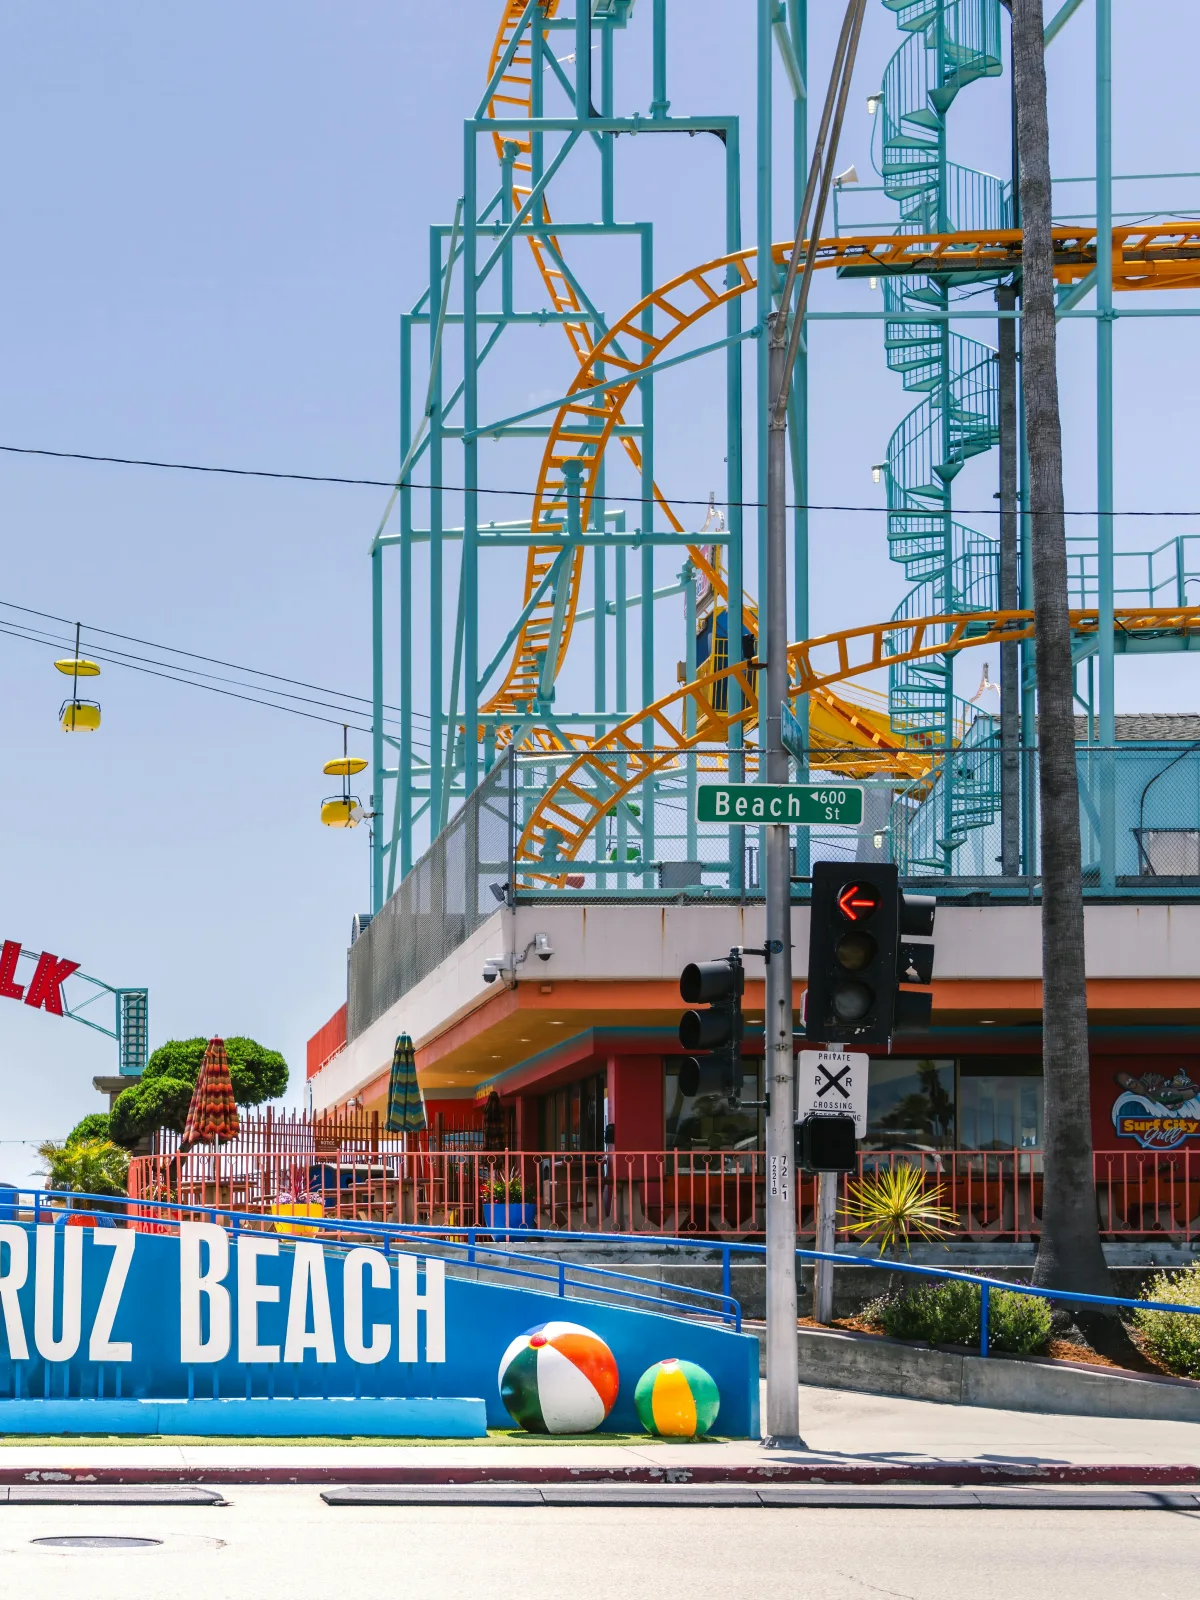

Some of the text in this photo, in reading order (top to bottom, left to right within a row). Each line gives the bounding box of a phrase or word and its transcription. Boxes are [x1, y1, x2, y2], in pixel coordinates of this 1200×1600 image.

[715, 791, 800, 817] Beach
[819, 791, 846, 805] 600
[825, 807, 840, 820] St
[818, 1052, 851, 1062] PRIVATE
[814, 1075, 853, 1087] R R
[813, 1100, 853, 1110] CROSSING
[1124, 1119, 1199, 1133] Surf City
[180, 1221, 446, 1366] BEACH
